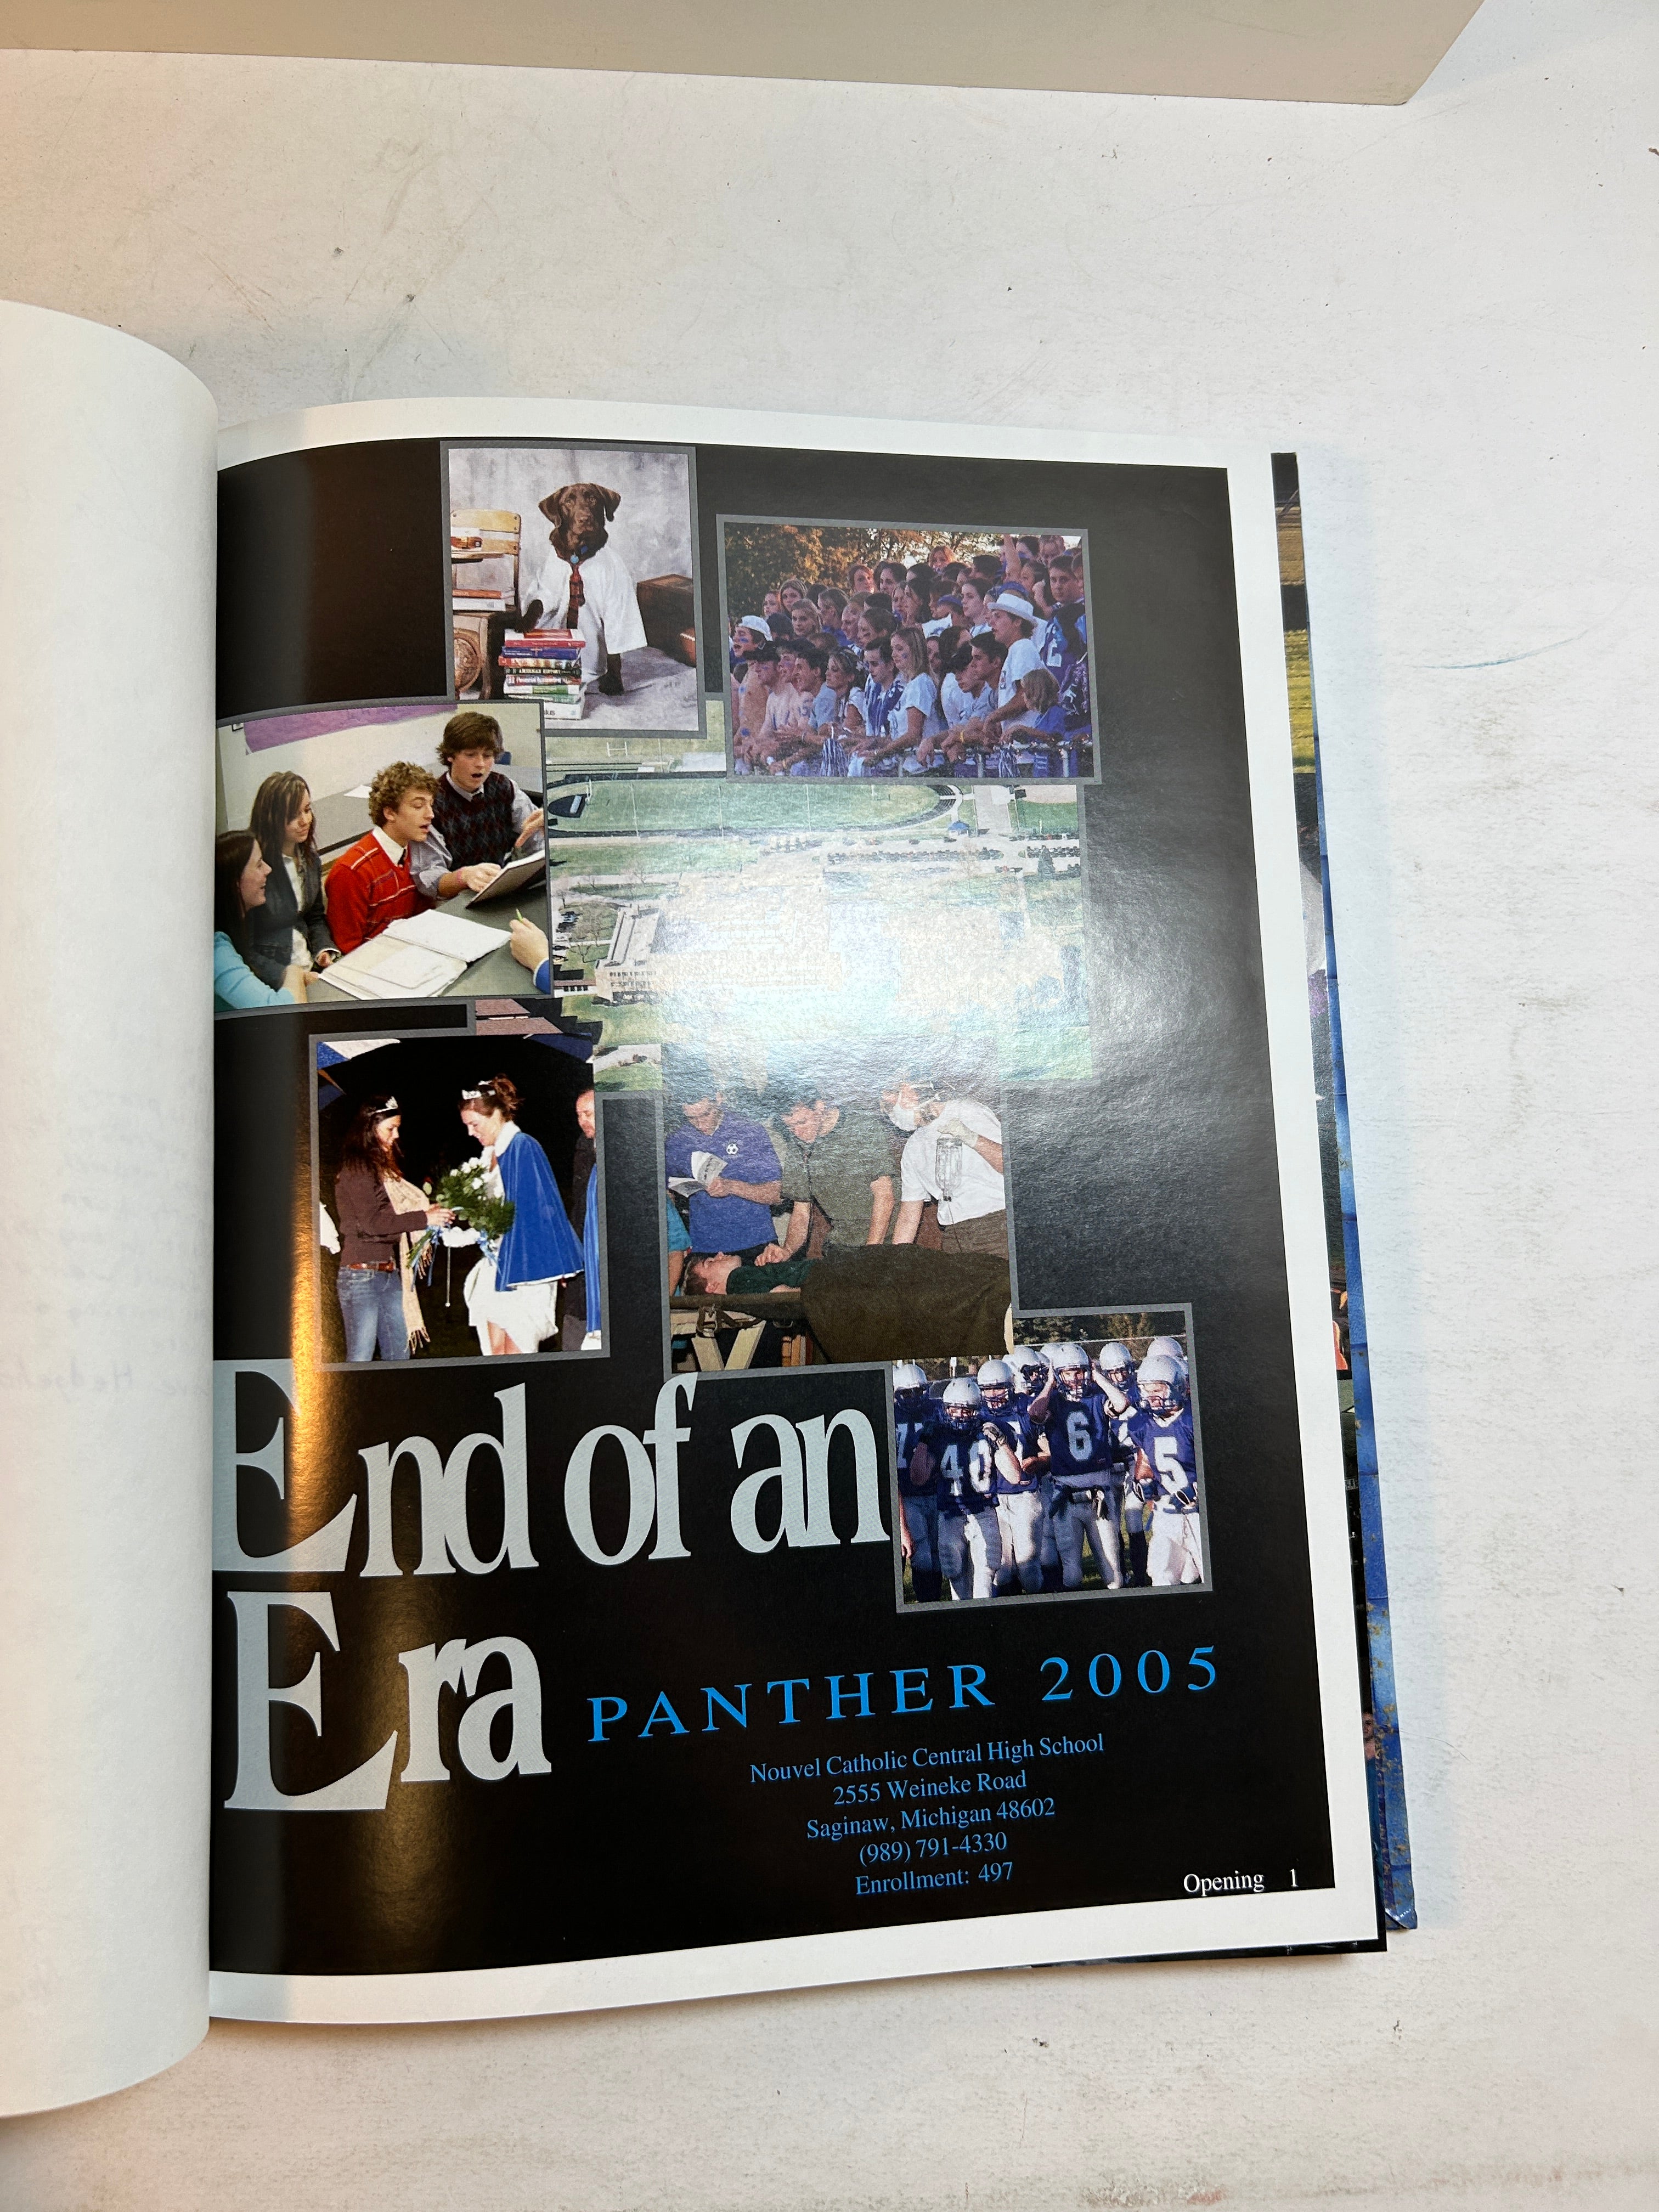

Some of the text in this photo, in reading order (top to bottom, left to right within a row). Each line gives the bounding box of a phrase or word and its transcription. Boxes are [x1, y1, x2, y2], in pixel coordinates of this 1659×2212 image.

[1066, 1410, 1093, 1462] 6
[212, 1359, 890, 1578] End of an
[940, 1438, 992, 1497] 40
[1154, 1436, 1189, 1495] 5
[224, 1591, 552, 1810] Era
[587, 1645, 1217, 1742] PANTHER 2005
[750, 1733, 1104, 1783] Nouvel Catholic Central High School
[833, 1770, 1027, 1805] 2555 Weineke Road
[806, 1797, 1056, 1841] Saginaw, Michigan 48602
[859, 1831, 1007, 1866] (989) 791-4330
[855, 1861, 1013, 1896] Enrollment: 497
[1183, 1869, 1298, 1897] Opening 1
